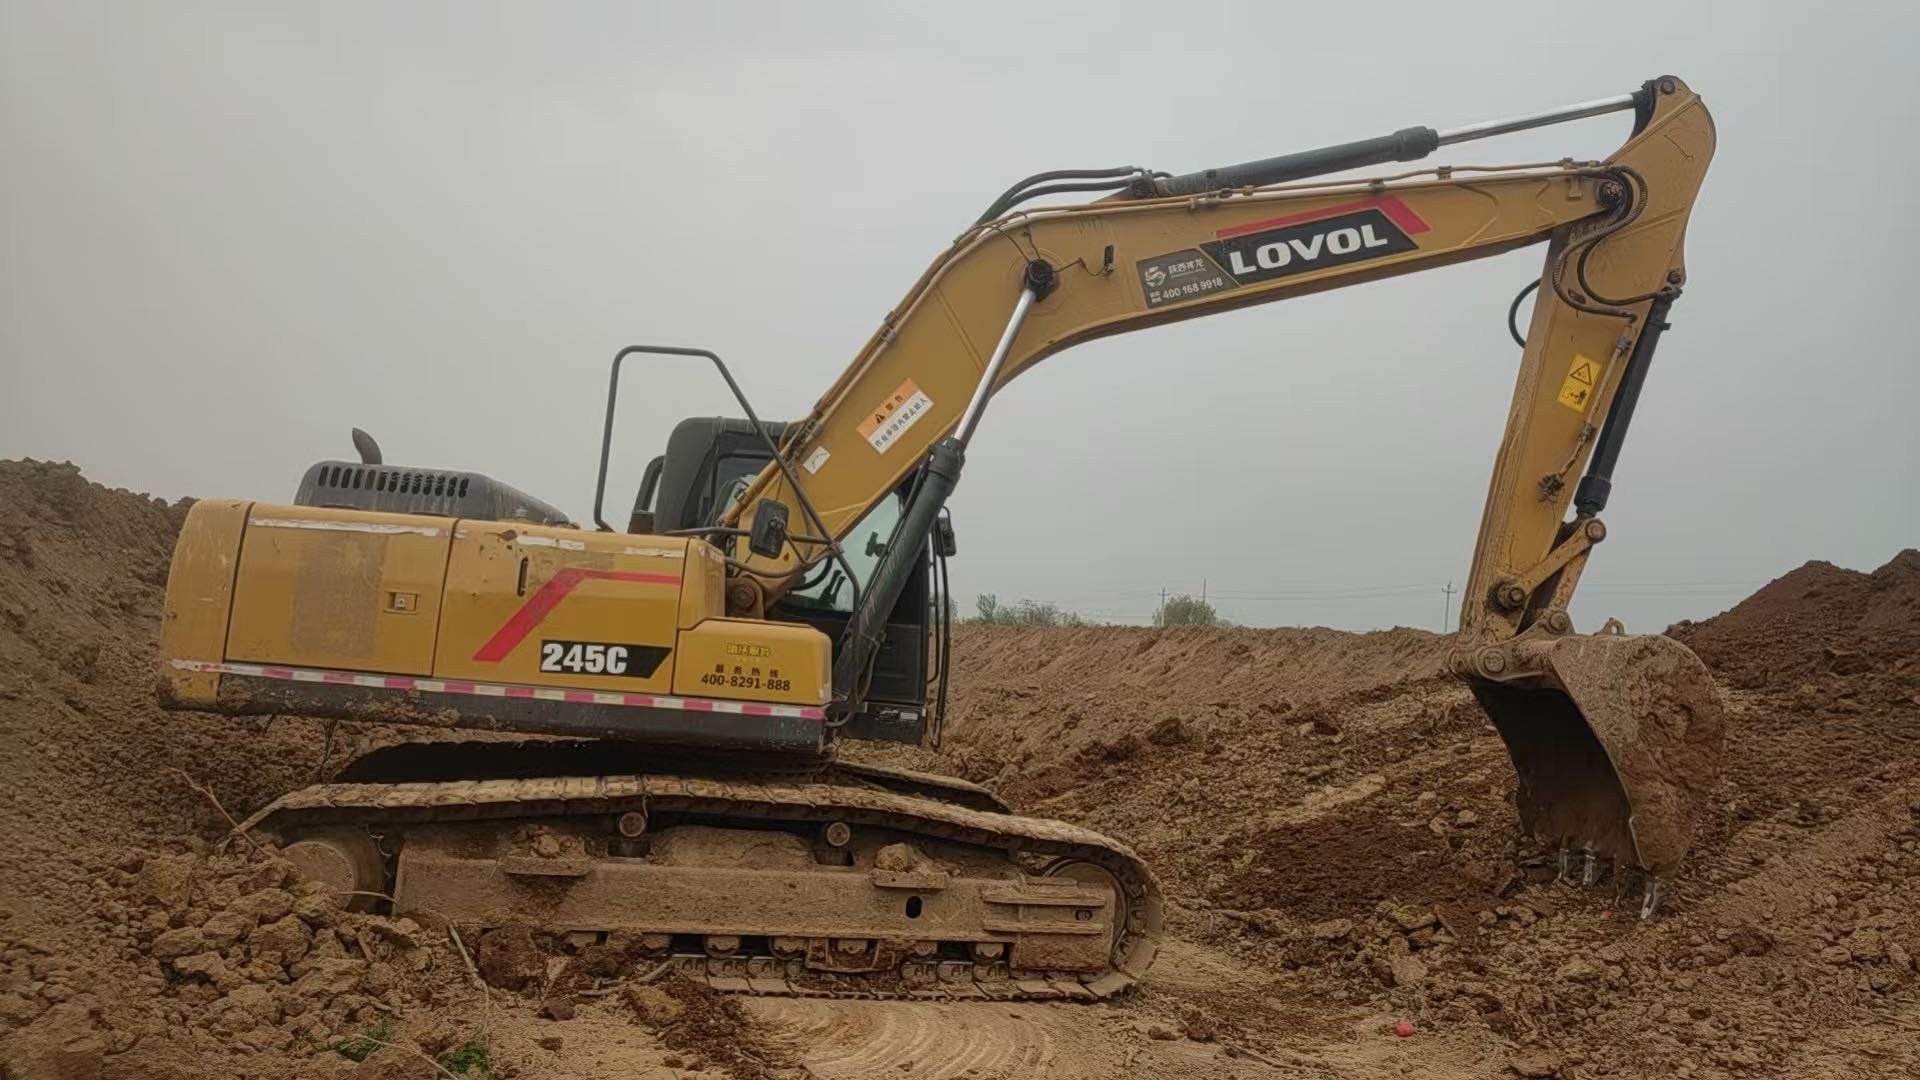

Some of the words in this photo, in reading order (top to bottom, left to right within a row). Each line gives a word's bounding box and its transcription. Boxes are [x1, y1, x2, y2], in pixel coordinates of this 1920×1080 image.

[1229, 224, 1388, 275] LOVOL
[1163, 287, 1181, 299] 400
[1182, 282, 1200, 295] 168
[1200, 276, 1224, 291] 9918
[541, 643, 628, 674] 245C
[701, 673, 791, 692] 400-8291-888
[715, 664, 779, 679] 服务热线
